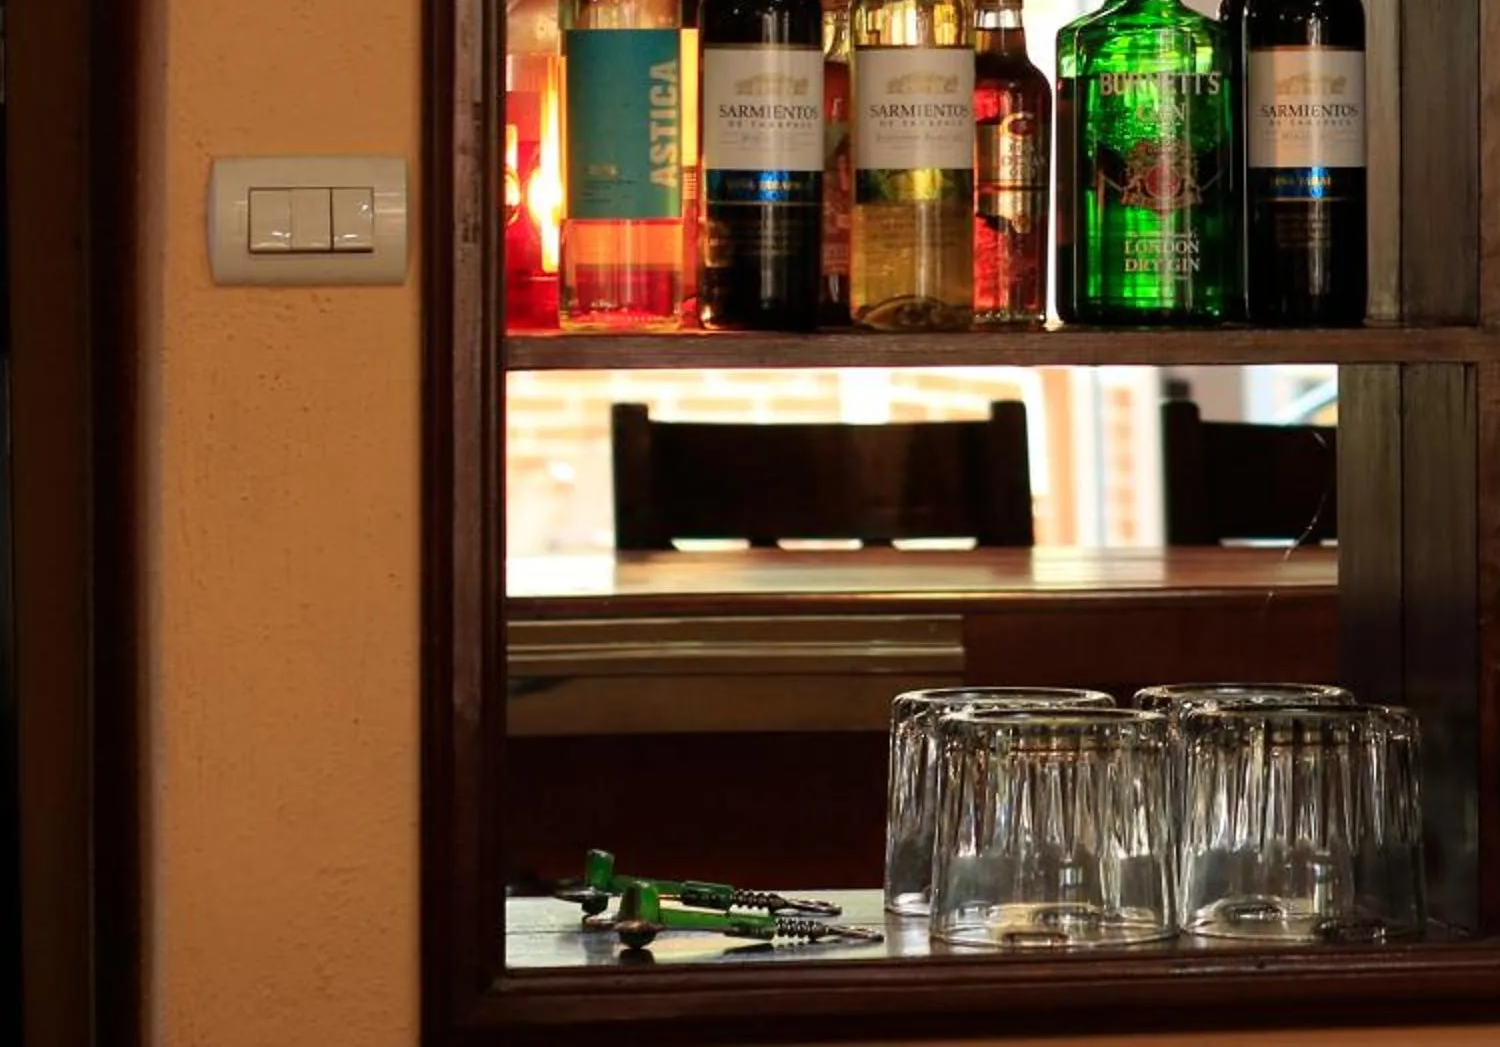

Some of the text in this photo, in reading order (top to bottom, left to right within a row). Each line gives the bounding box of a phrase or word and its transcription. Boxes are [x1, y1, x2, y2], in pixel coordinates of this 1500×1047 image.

[719, 104, 819, 121] SARMIENTOS
[869, 104, 970, 119] SARMIENTOS
[1260, 104, 1359, 118] SARMIENTOS
[650, 60, 678, 188] ASTICA
[1125, 240, 1200, 254] LONDON
